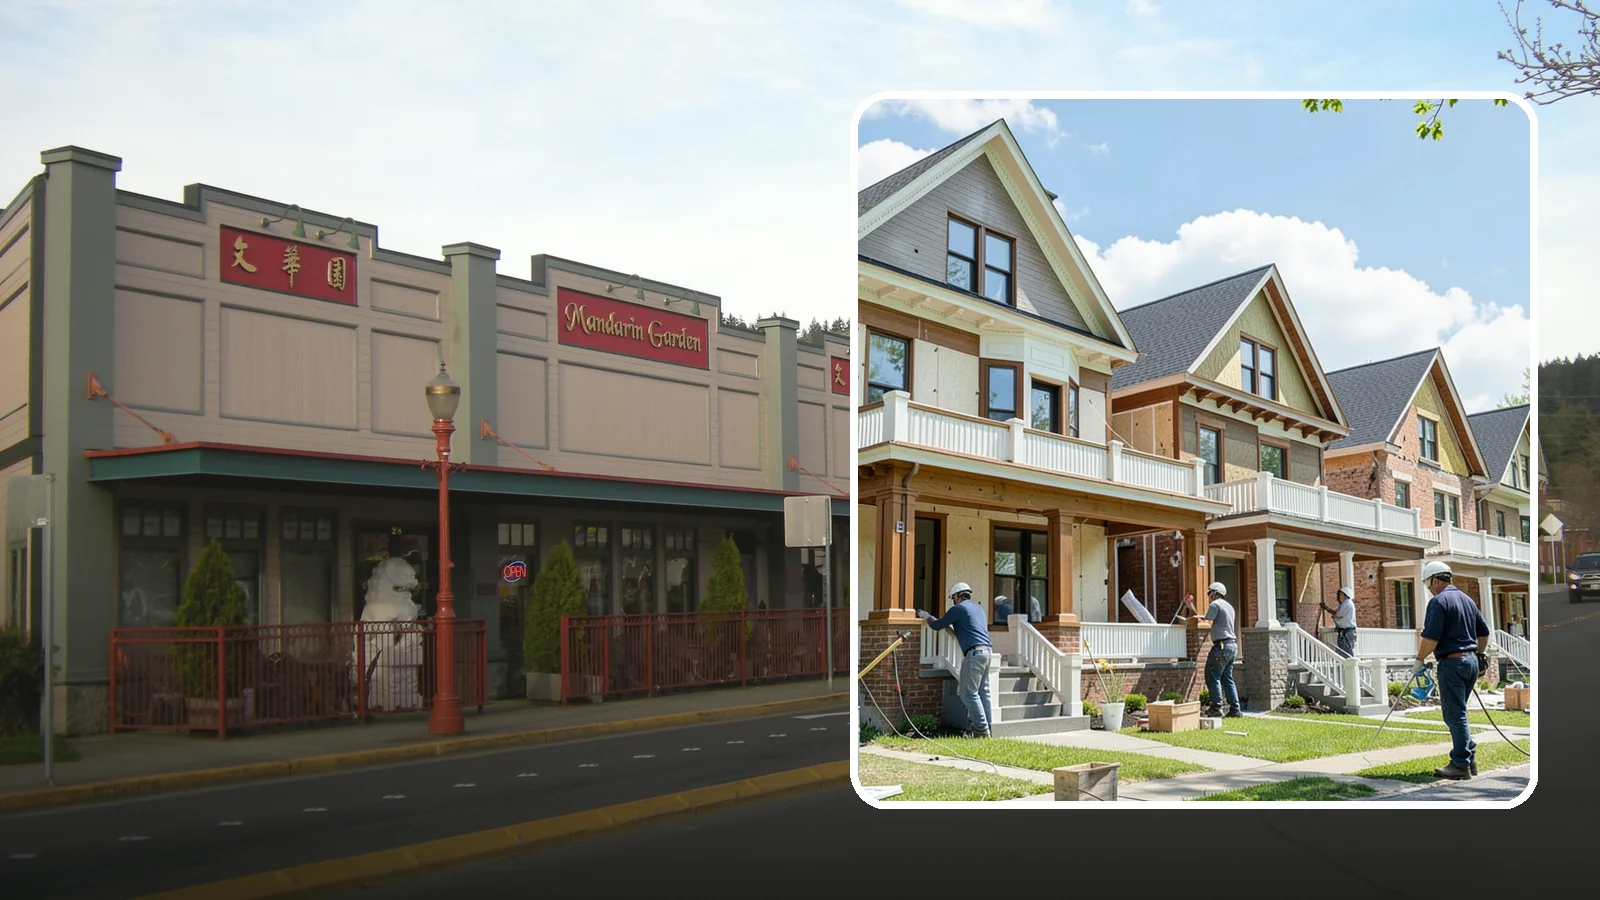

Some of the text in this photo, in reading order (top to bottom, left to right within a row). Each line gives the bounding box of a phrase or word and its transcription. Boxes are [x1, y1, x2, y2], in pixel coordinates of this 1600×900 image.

[230, 235, 346, 291] 文華園
[564, 302, 702, 352] Mandarin Garden
[503, 565, 527, 578] OPEN
